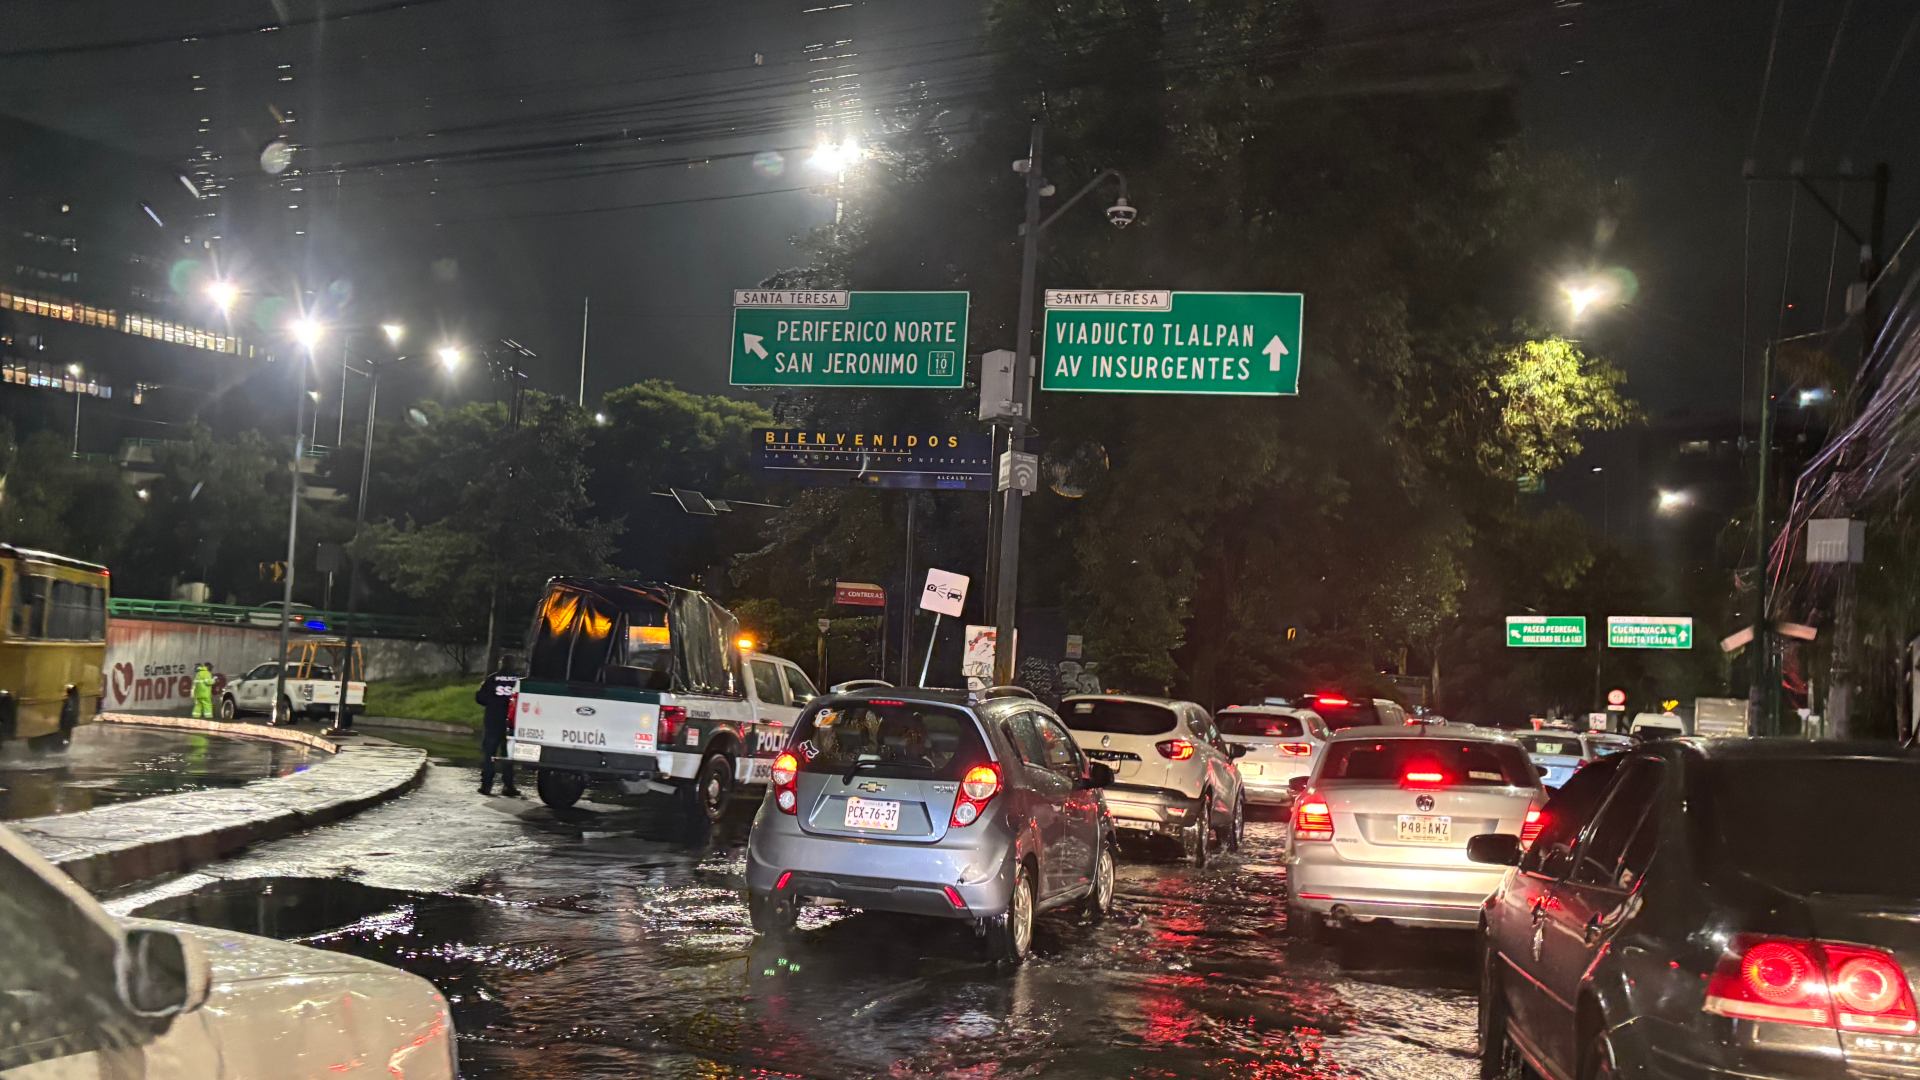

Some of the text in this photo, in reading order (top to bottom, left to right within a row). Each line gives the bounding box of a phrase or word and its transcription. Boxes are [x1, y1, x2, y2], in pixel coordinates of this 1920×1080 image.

[743, 292, 838, 304] SANTA TERESA
[1055, 293, 1159, 305] SANTA TERESA
[776, 320, 957, 343] PERIFERICO NORTE
[1056, 322, 1254, 347] VIADUCTO TLALPAN
[774, 352, 918, 375] SAN JERONIMO
[935, 358, 947, 369] 10
[1054, 355, 1250, 381] AV INSURGENTES
[765, 431, 958, 448] BIENVENIDOS
[823, 446, 911, 454] TERRITORIAL
[793, 454, 881, 462] MAGDALENA
[896, 457, 987, 465] CONTRERAS
[847, 591, 883, 599] CONTRERAS
[1523, 625, 1581, 634] PASEO PEDREGAL
[1612, 625, 1667, 635] CUERNAVACA
[1562, 635, 1570, 643] LA
[135, 673, 227, 702] morea
[562, 729, 607, 746] POLICÍA
[848, 805, 897, 821] PCX-76-37
[1401, 822, 1448, 835] P48-AWZ
